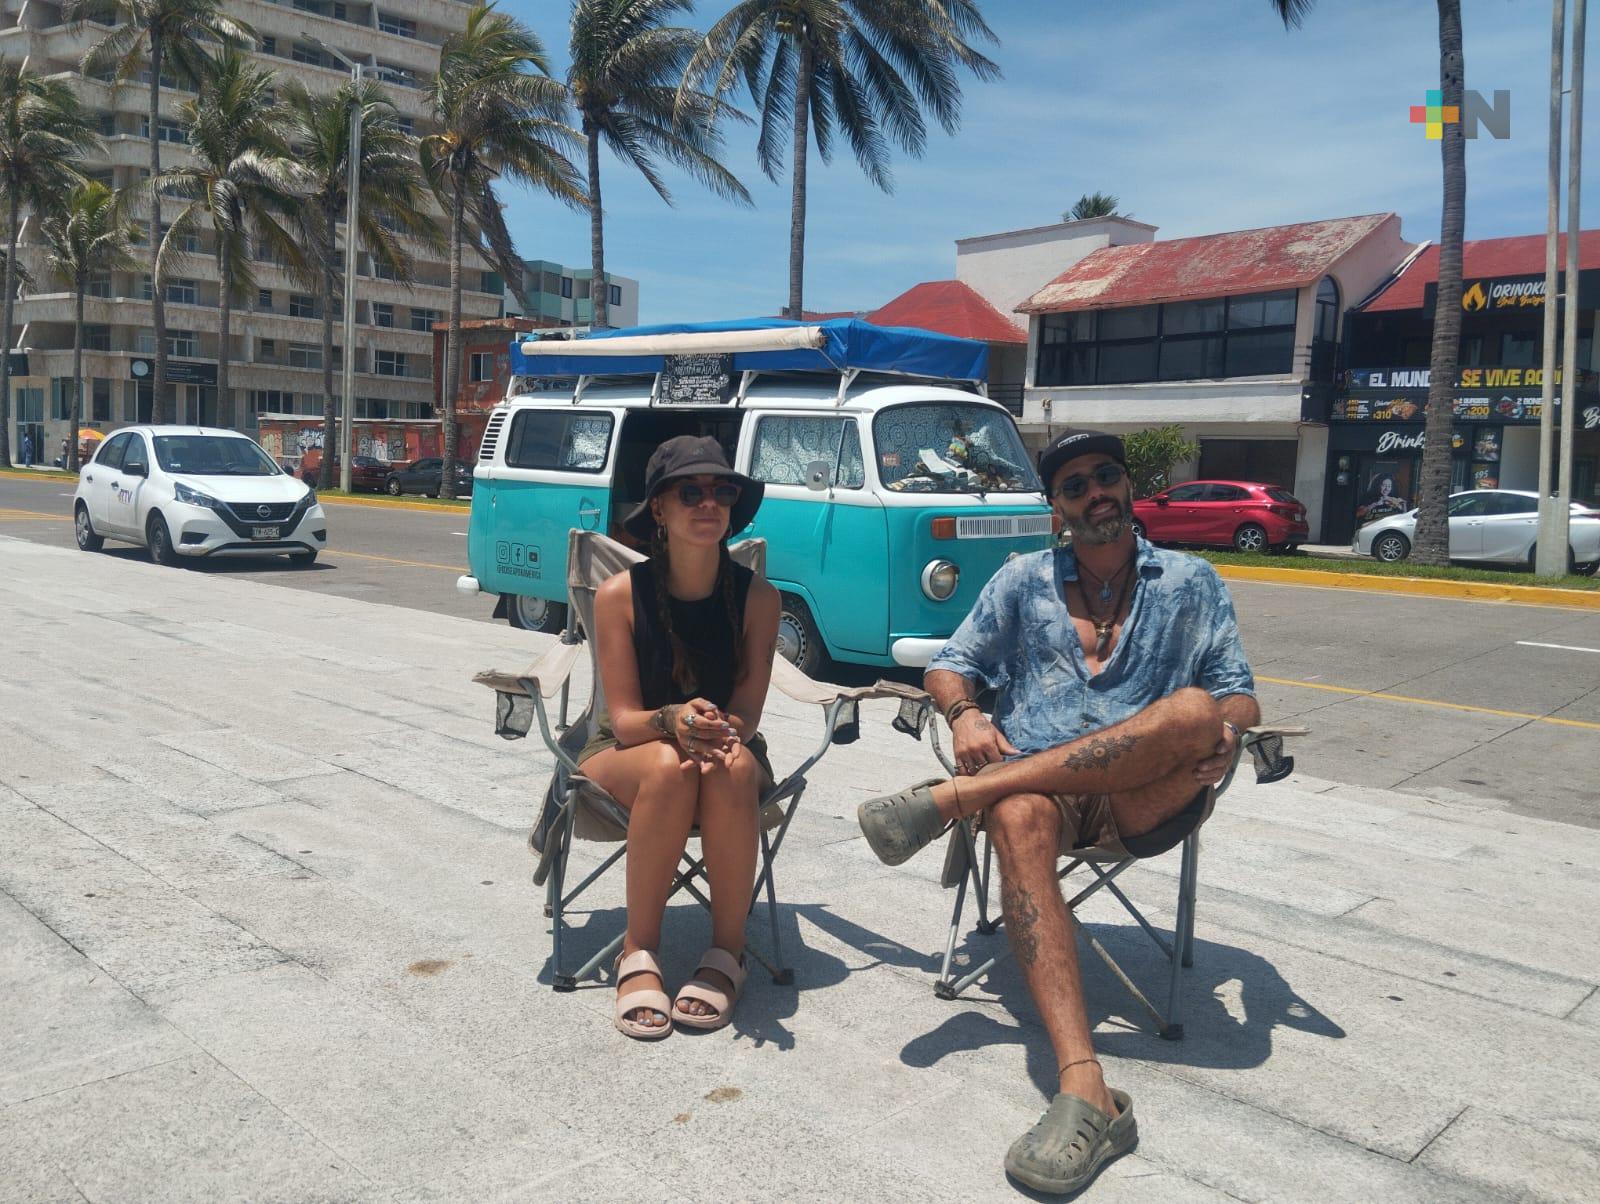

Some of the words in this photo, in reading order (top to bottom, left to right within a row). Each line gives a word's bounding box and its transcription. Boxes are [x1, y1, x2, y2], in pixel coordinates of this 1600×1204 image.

[1368, 373, 1387, 388] EL
[1461, 369, 1482, 388] SE
[1485, 368, 1522, 387] VIVE
